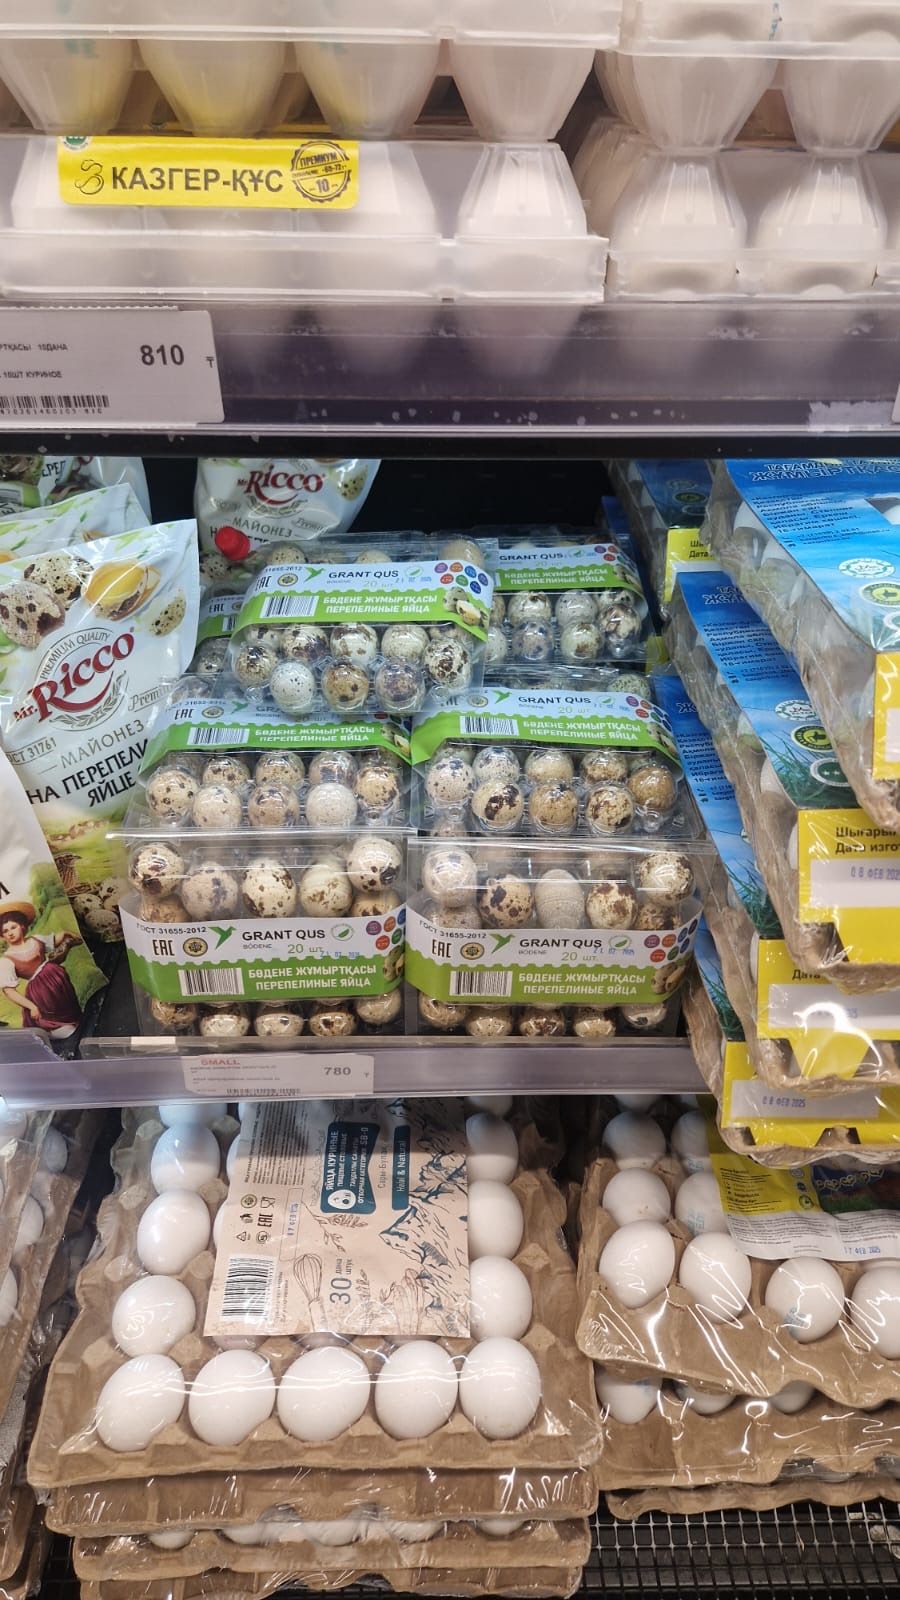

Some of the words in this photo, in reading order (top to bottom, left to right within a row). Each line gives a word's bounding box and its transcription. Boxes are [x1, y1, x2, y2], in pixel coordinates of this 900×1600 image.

[316, 178, 329, 193] 10
[139, 344, 185, 366] 810
[232, 517, 292, 538] МАЙОНЕЗ
[328, 571, 372, 579] GRANT
[373, 570, 399, 579] QUS
[326, 605, 400, 614] ПЕРЕПЕЛИНЫЕ
[401, 603, 430, 614] ЯЙЦА
[77, 631, 110, 646] QUALITY
[40, 639, 75, 679] PREMIUM
[13, 703, 38, 722] Mr.
[28, 631, 135, 722] Ricco
[518, 696, 562, 704] GRANT
[565, 696, 592, 704] QUS
[340, 734, 369, 742] ЯЙЦА
[530, 729, 607, 739] ПЕРЕПЕЛИНЫЕ
[608, 731, 637, 740] ЯЙЦА
[28, 737, 57, 759] 31761
[61, 719, 145, 769] МАЙОНЕЗ
[26, 784, 61, 805] НА
[87, 770, 137, 807] ЯЙЦЕ
[158, 926, 207, 935] 31655-2012
[242, 930, 293, 941] GRANT
[295, 929, 326, 940] QUS
[420, 919, 438, 934] ГОСТ
[440, 930, 487, 939] 31655-2012
[152, 939, 175, 956] EAC
[288, 944, 304, 954] 20
[432, 938, 452, 958] EAC
[519, 938, 569, 948] GRANT
[572, 938, 602, 949] QUS
[561, 951, 578, 961] 20
[248, 967, 293, 979] БӨДЕНЕ
[518, 973, 562, 984] БӨДЕНЕ
[256, 979, 337, 991] ПЕРЕПЕЛИНЫЕ
[340, 977, 372, 989] ЯЙЦА
[523, 985, 605, 995] ПЕРЕПЕЛИНЫЕ
[607, 984, 637, 995] ЯЙЦА
[323, 1066, 351, 1076] 780
[328, 1131, 339, 1167] КУРИНЫЕ
[397, 1140, 406, 1168] Natural
[325, 1168, 336, 1191] ЯЙЦА
[346, 1258, 354, 1275] штук
[329, 1277, 352, 1305] 30
